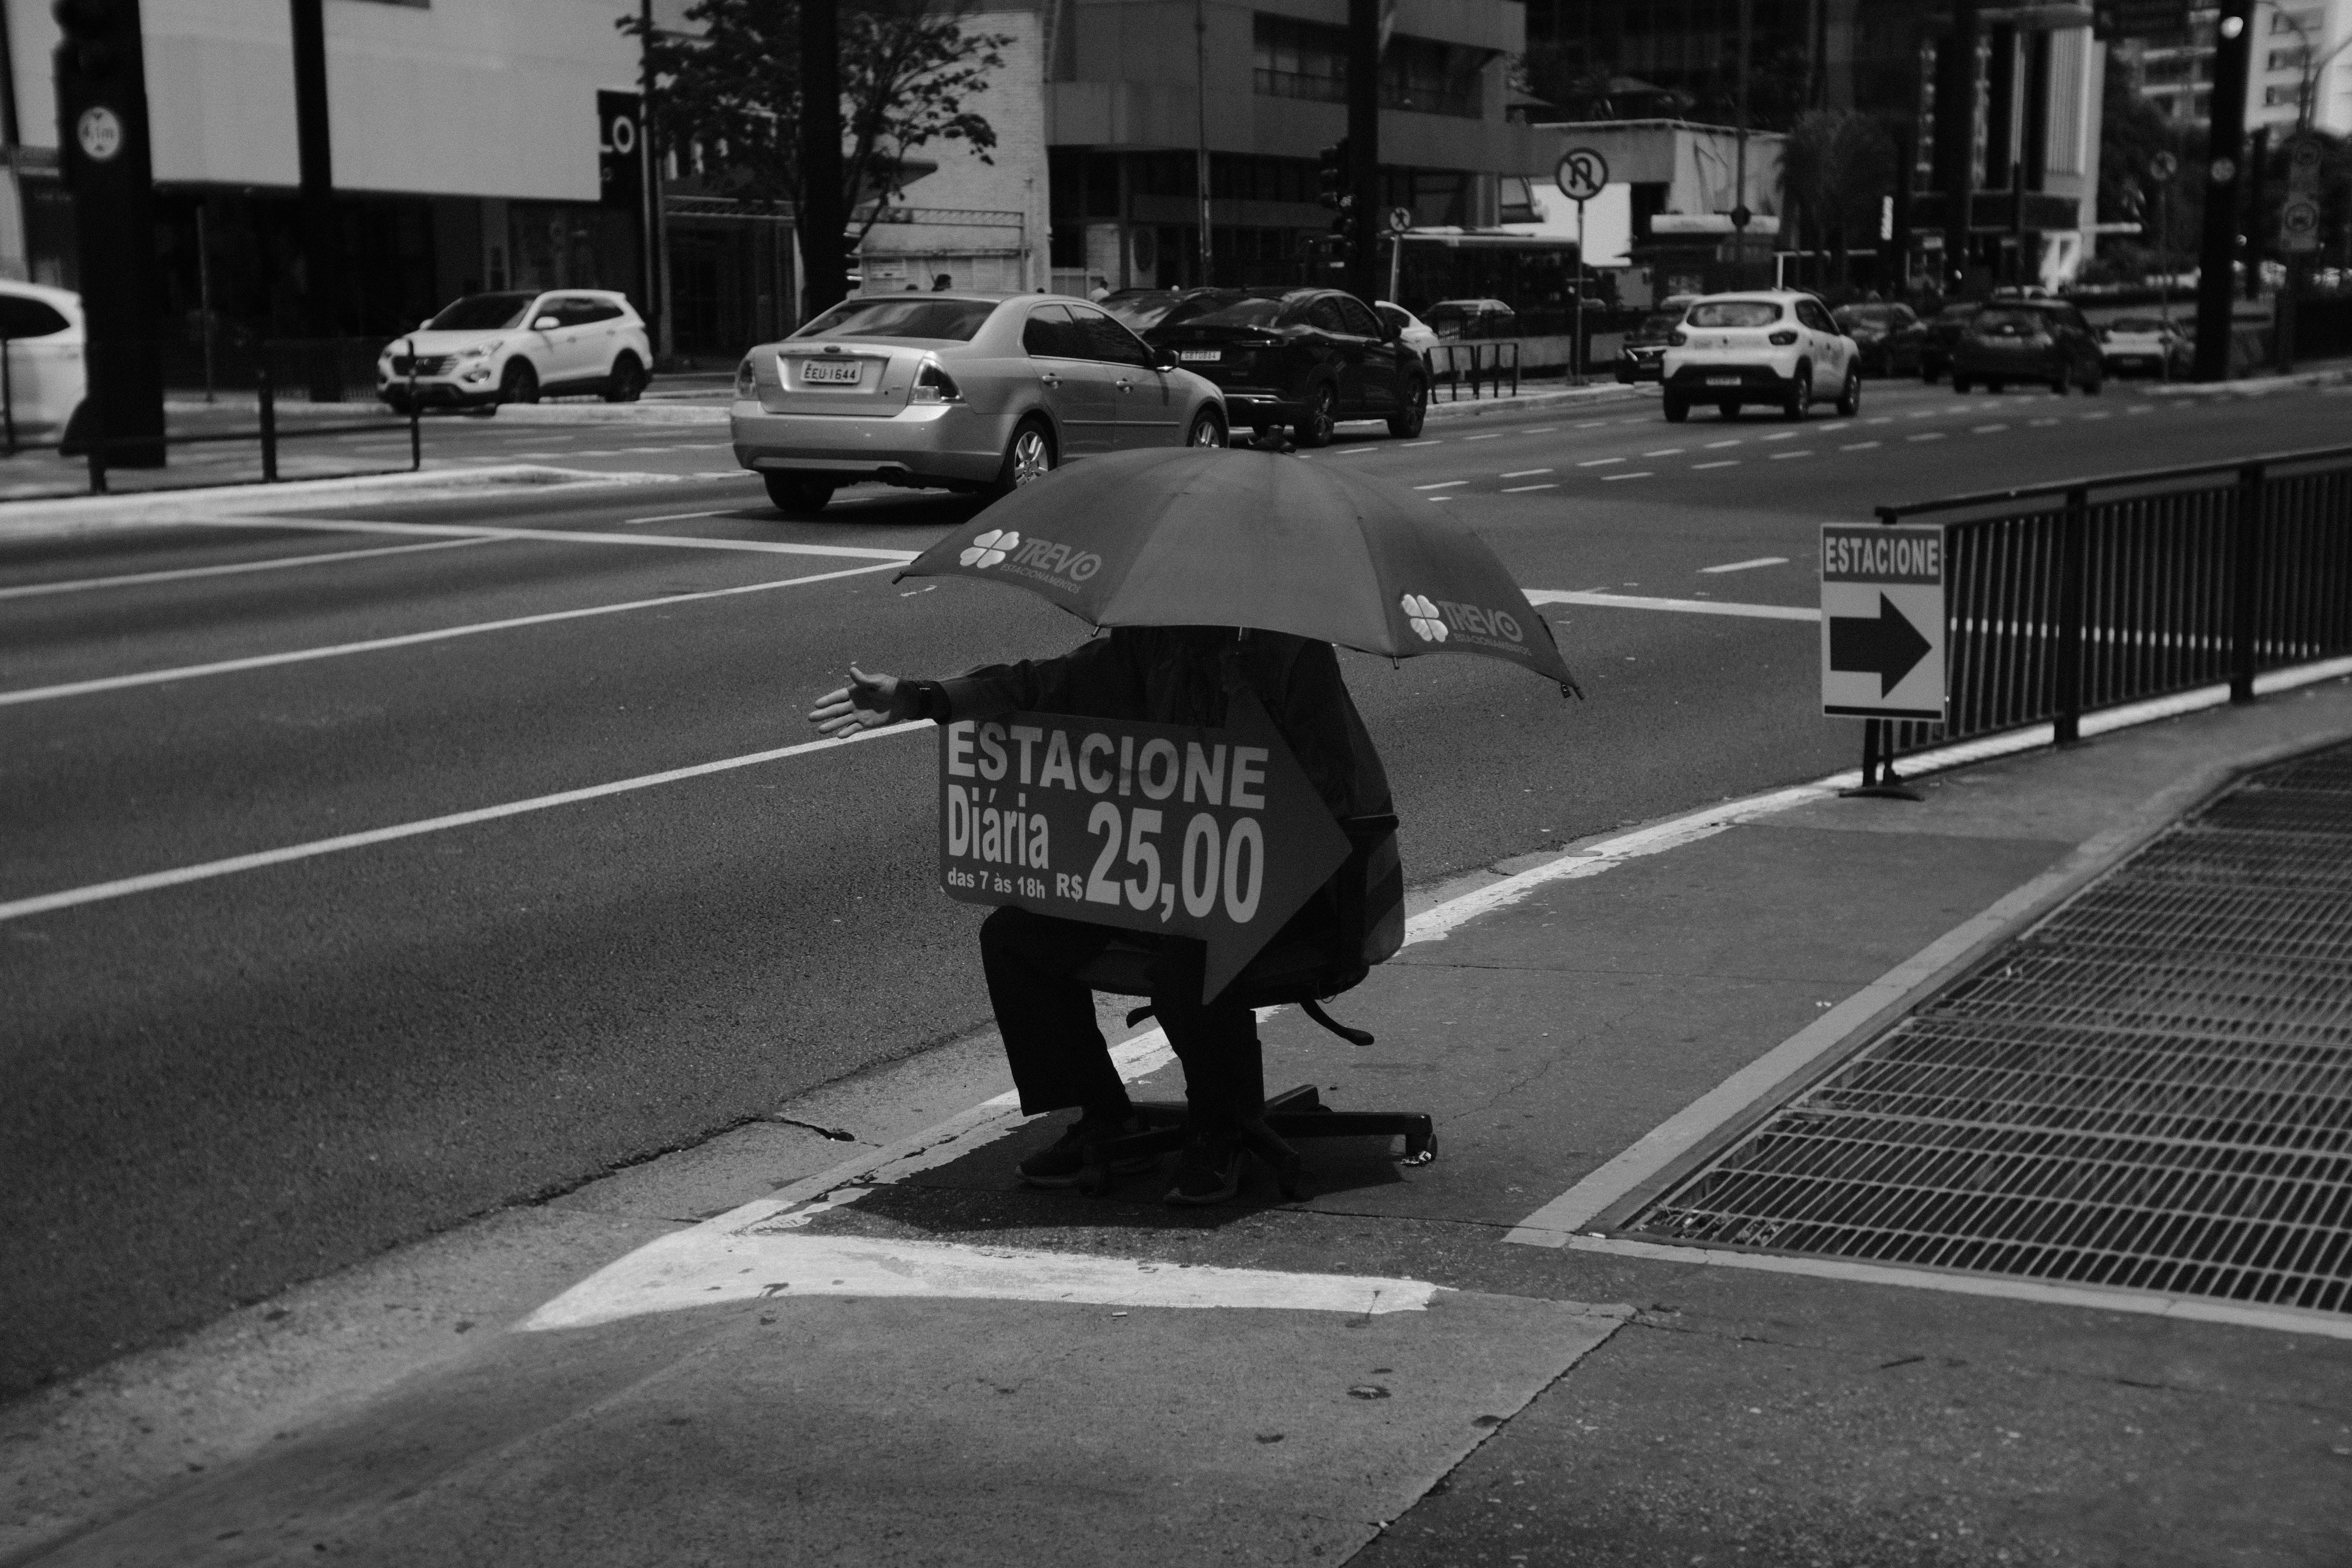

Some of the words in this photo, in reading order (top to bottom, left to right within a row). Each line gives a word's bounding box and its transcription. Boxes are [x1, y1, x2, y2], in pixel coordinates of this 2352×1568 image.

[1012, 537, 1102, 581] TREVO
[1825, 537, 1939, 576] ESTACIONE
[1000, 563, 1082, 594] ESTACIONAMENTOS
[1436, 600, 1524, 642] TREVO
[948, 719, 1268, 810] ESTACIONE
[948, 784, 1050, 870] Diária
[947, 867, 975, 888] das
[979, 870, 989, 890] 7
[994, 872, 1012, 894] às
[1017, 876, 1046, 899] 18h
[1056, 872, 1083, 902] R$
[1085, 801, 1265, 924] 25,00
